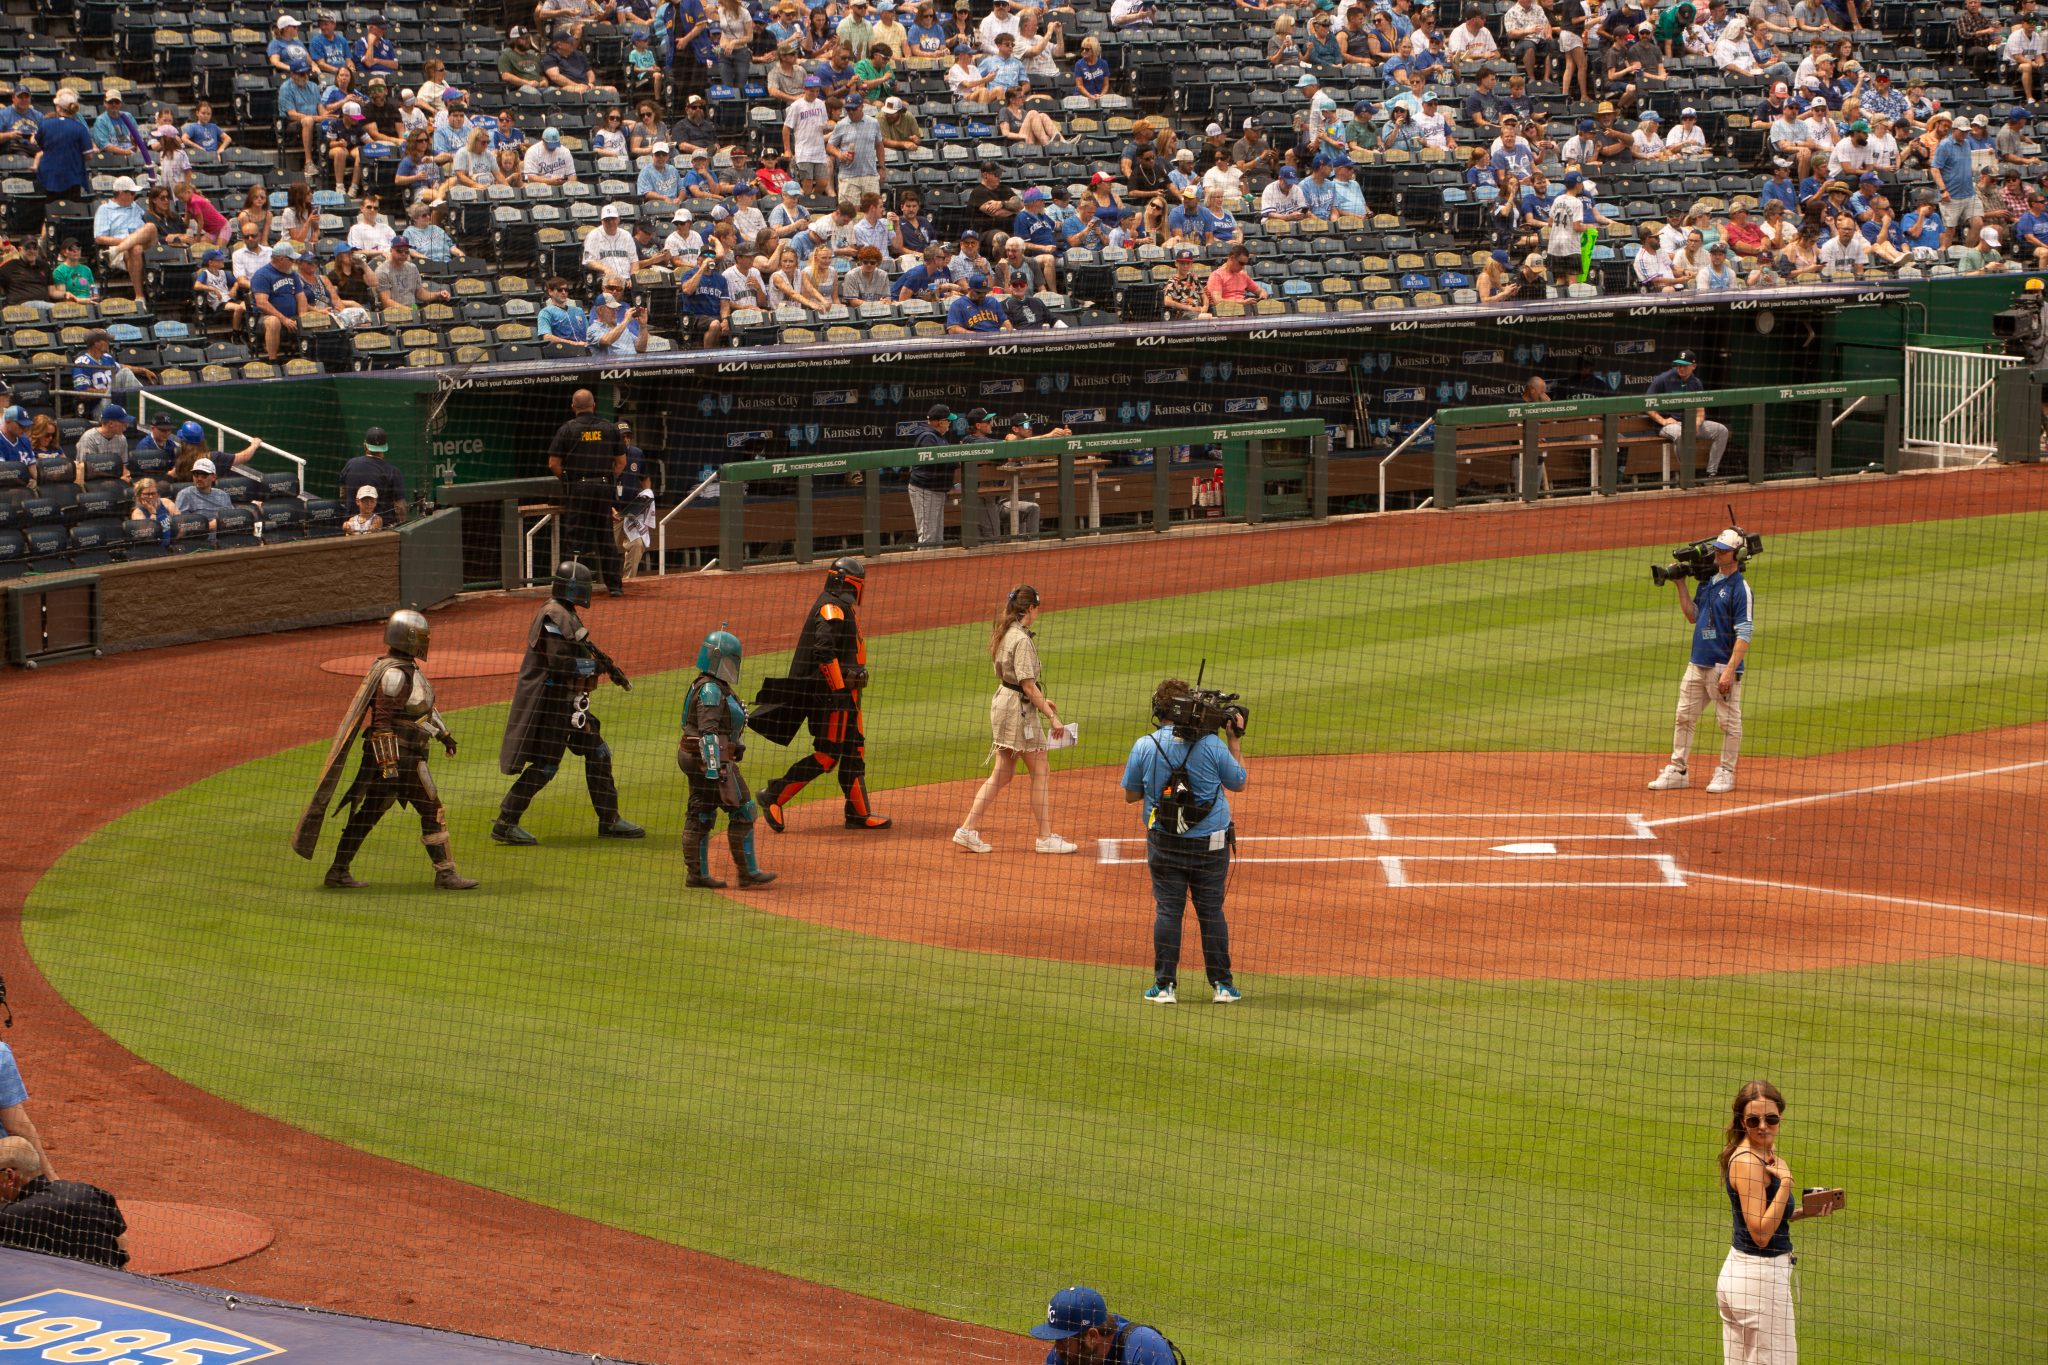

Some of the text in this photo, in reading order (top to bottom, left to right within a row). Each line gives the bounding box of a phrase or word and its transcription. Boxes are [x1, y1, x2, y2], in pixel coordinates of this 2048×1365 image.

[1084, 68, 1104, 80] Royals
[800, 108, 823, 120] ROYALTY
[539, 158, 566, 175] Royals
[1276, 199, 1298, 212] Royals
[1730, 300, 1757, 310] KIA
[1830, 296, 1845, 304] Dealer
[1858, 292, 1884, 302] KIA
[1630, 306, 1657, 316] KIA
[1695, 305, 1714, 313] inspires
[1391, 321, 1418, 331] KIA
[1420, 322, 1446, 330] Movement
[1456, 320, 1476, 328] inspires
[1497, 314, 1524, 325] KIA
[1250, 330, 1278, 340] KIA
[1323, 328, 1333, 336] City
[1356, 326, 1372, 334] Dealer
[1136, 336, 1165, 346] KIA
[1207, 335, 1227, 343] inspires
[988, 345, 1018, 356] KIA
[1064, 344, 1074, 352] City
[1548, 344, 1603, 357] Kansas City
[1680, 351, 1686, 360] S
[872, 352, 902, 363] KIA
[945, 351, 966, 359] inspires
[1395, 354, 1451, 368] Kansas City
[718, 362, 748, 372] KIA
[798, 360, 808, 368] City
[834, 358, 850, 366] Dealer
[1237, 362, 1294, 376] Kansas City
[601, 367, 694, 380] KIA Movement that inspires
[1073, 372, 1133, 387] Kansas City
[476, 380, 488, 388] Visit
[503, 378, 522, 386] Kansas
[524, 378, 536, 386] City
[560, 374, 578, 382] Dealer
[908, 384, 969, 398] Kansas City
[1471, 382, 1526, 396] Kansas City
[1780, 389, 1794, 398] TFL
[737, 394, 801, 409] Kansas City
[1315, 393, 1351, 406] Kansas
[1645, 396, 1714, 407] TFL TICKETSFORLESS.COM
[1155, 402, 1214, 416] Kansas City
[1508, 405, 1578, 417] TFL TICKETSFORLESS.COM
[581, 431, 602, 441] POLICE
[824, 424, 885, 438] Kansas City
[1213, 427, 1286, 439] TFL TICKETSFORLESS.COM
[1067, 437, 1142, 450] TFL TICKETSFORLESS.COM
[918, 448, 994, 462] TFL TICKETSFORLESS.COM
[772, 460, 847, 473] TFL TICKETSFORLESS.COM
